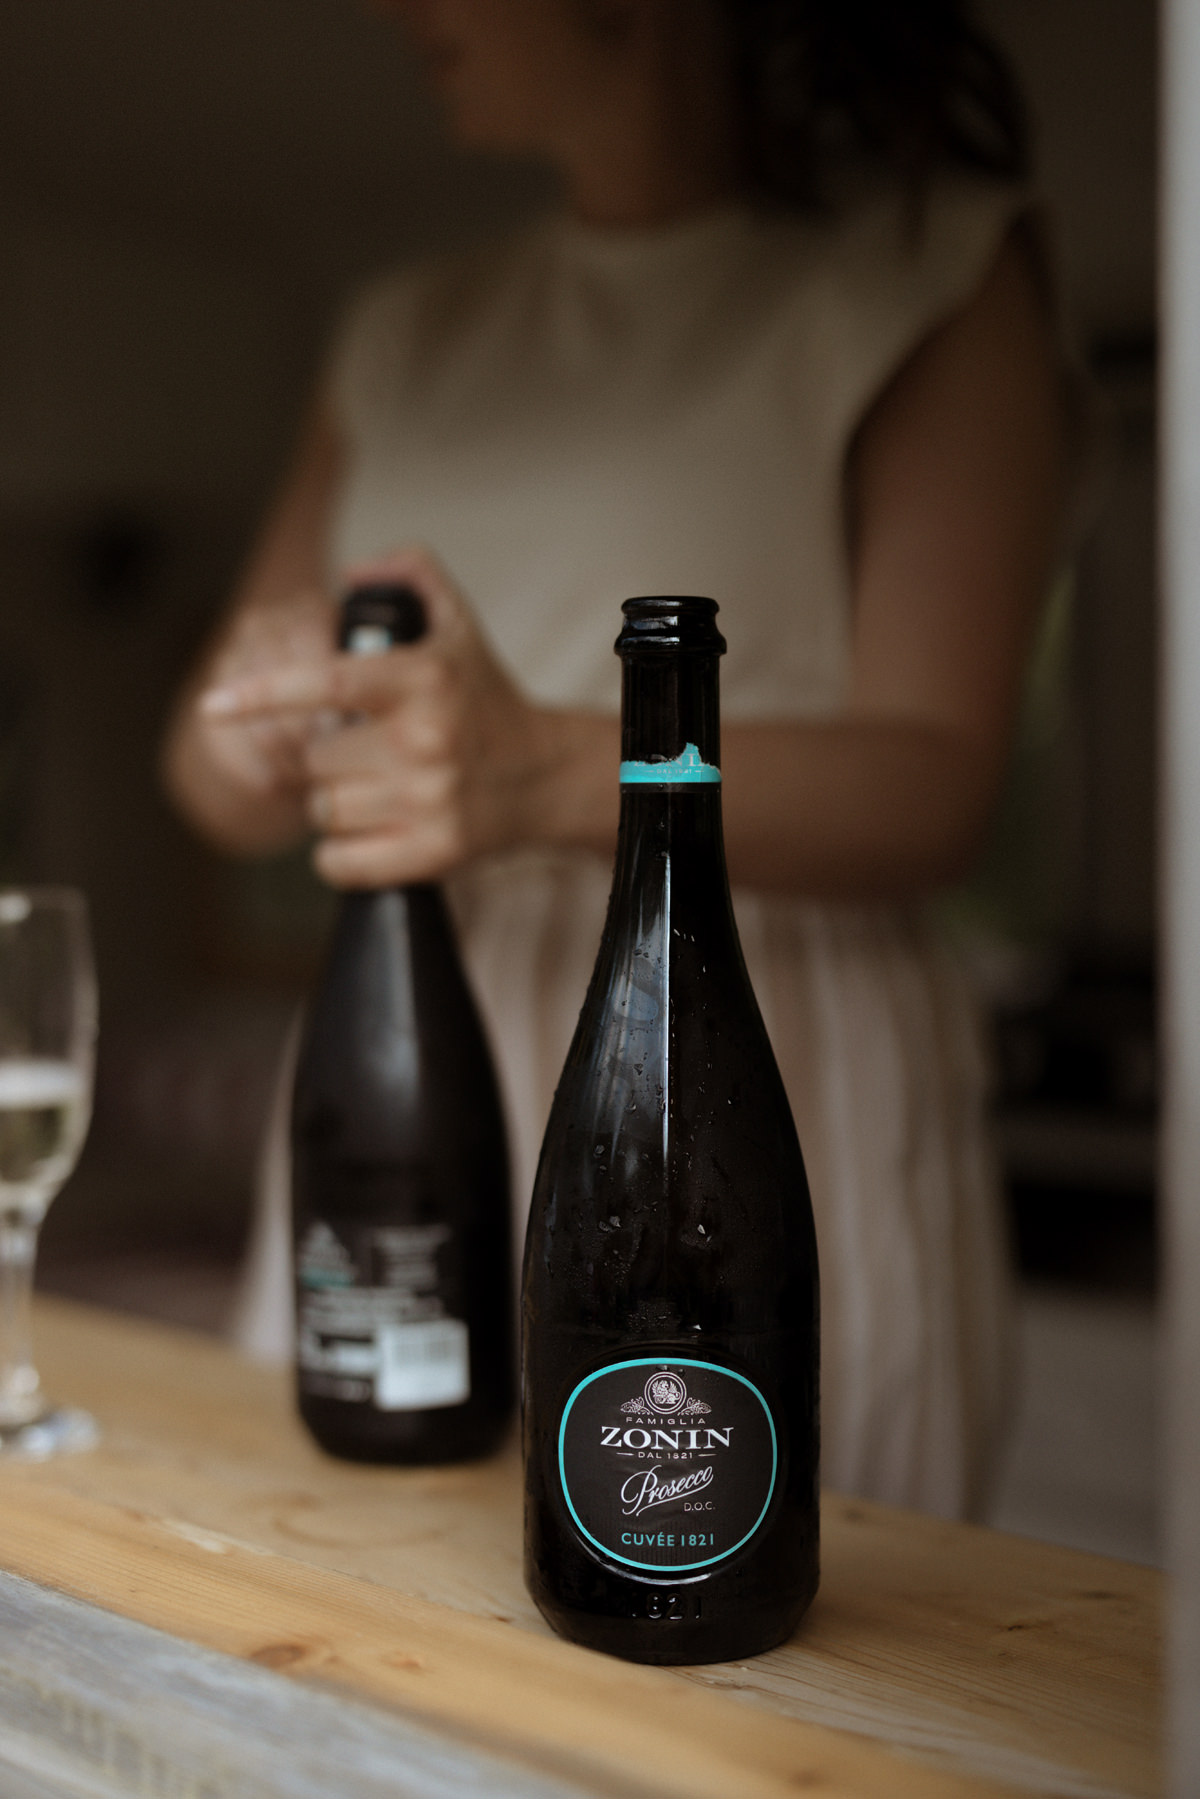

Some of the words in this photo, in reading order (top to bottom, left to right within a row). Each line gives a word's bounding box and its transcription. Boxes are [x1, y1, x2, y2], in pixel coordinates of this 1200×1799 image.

[625, 1416, 706, 1425] FAMIGLIA
[600, 1426, 734, 1450] ZONIN
[638, 1451, 662, 1459] DAL
[621, 1464, 714, 1517] Prosecco
[683, 1501, 716, 1512] D.O.C.
[621, 1531, 675, 1547] CUVÉE
[681, 1533, 714, 1547] 1821
